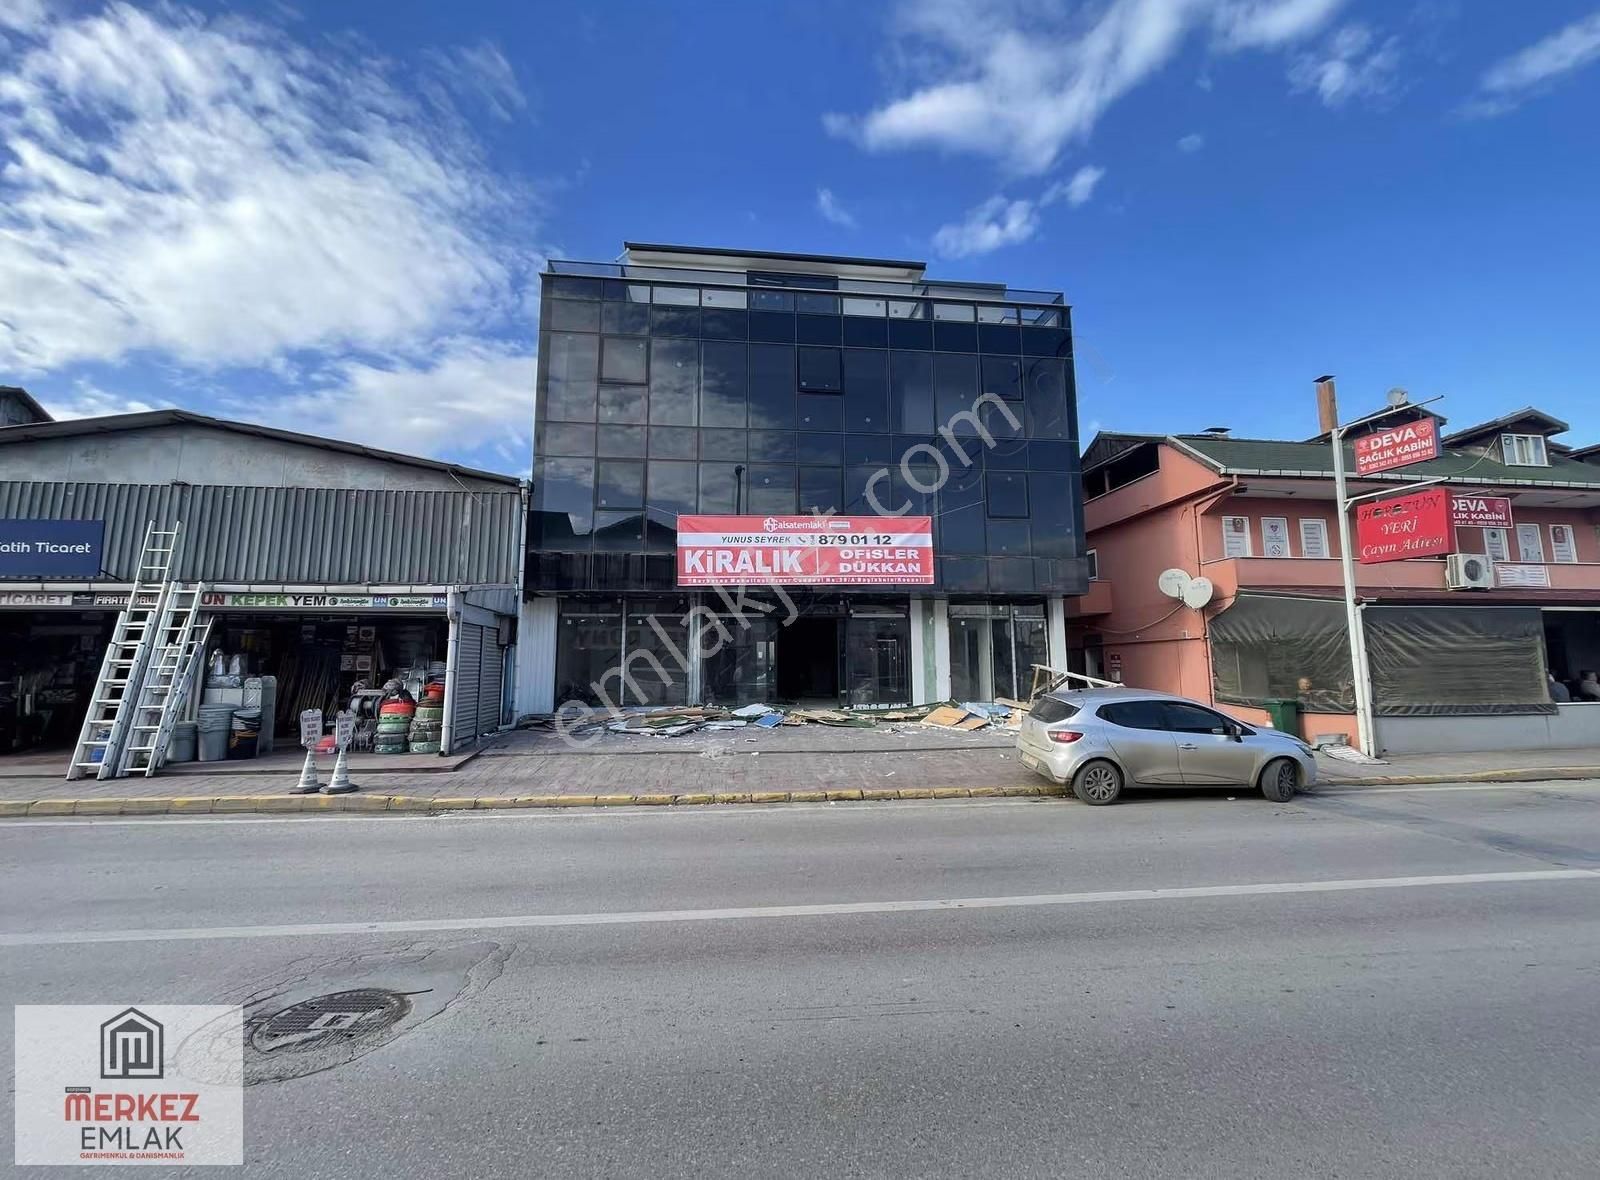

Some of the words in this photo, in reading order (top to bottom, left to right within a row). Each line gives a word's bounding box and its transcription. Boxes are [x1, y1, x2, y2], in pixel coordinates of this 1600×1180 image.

[1370, 427, 1417, 450] DEVA
[1359, 448, 1395, 465] SAĞLIK
[1396, 435, 1433, 456] KABİNİ
[1471, 511, 1506, 521] KABİNİ
[1380, 515, 1418, 535] YERİ
[721, 535, 753, 544] YUNUS
[753, 535, 792, 544] SEYREK
[818, 534, 848, 545] 879
[850, 534, 868, 545] 01
[873, 534, 893, 545] 12
[35, 541, 92, 553] Ticaret
[839, 560, 921, 574] DÜKKAN
[201, 594, 226, 605] UN
[231, 594, 288, 606] KEPEK
[291, 595, 327, 606] YEM
